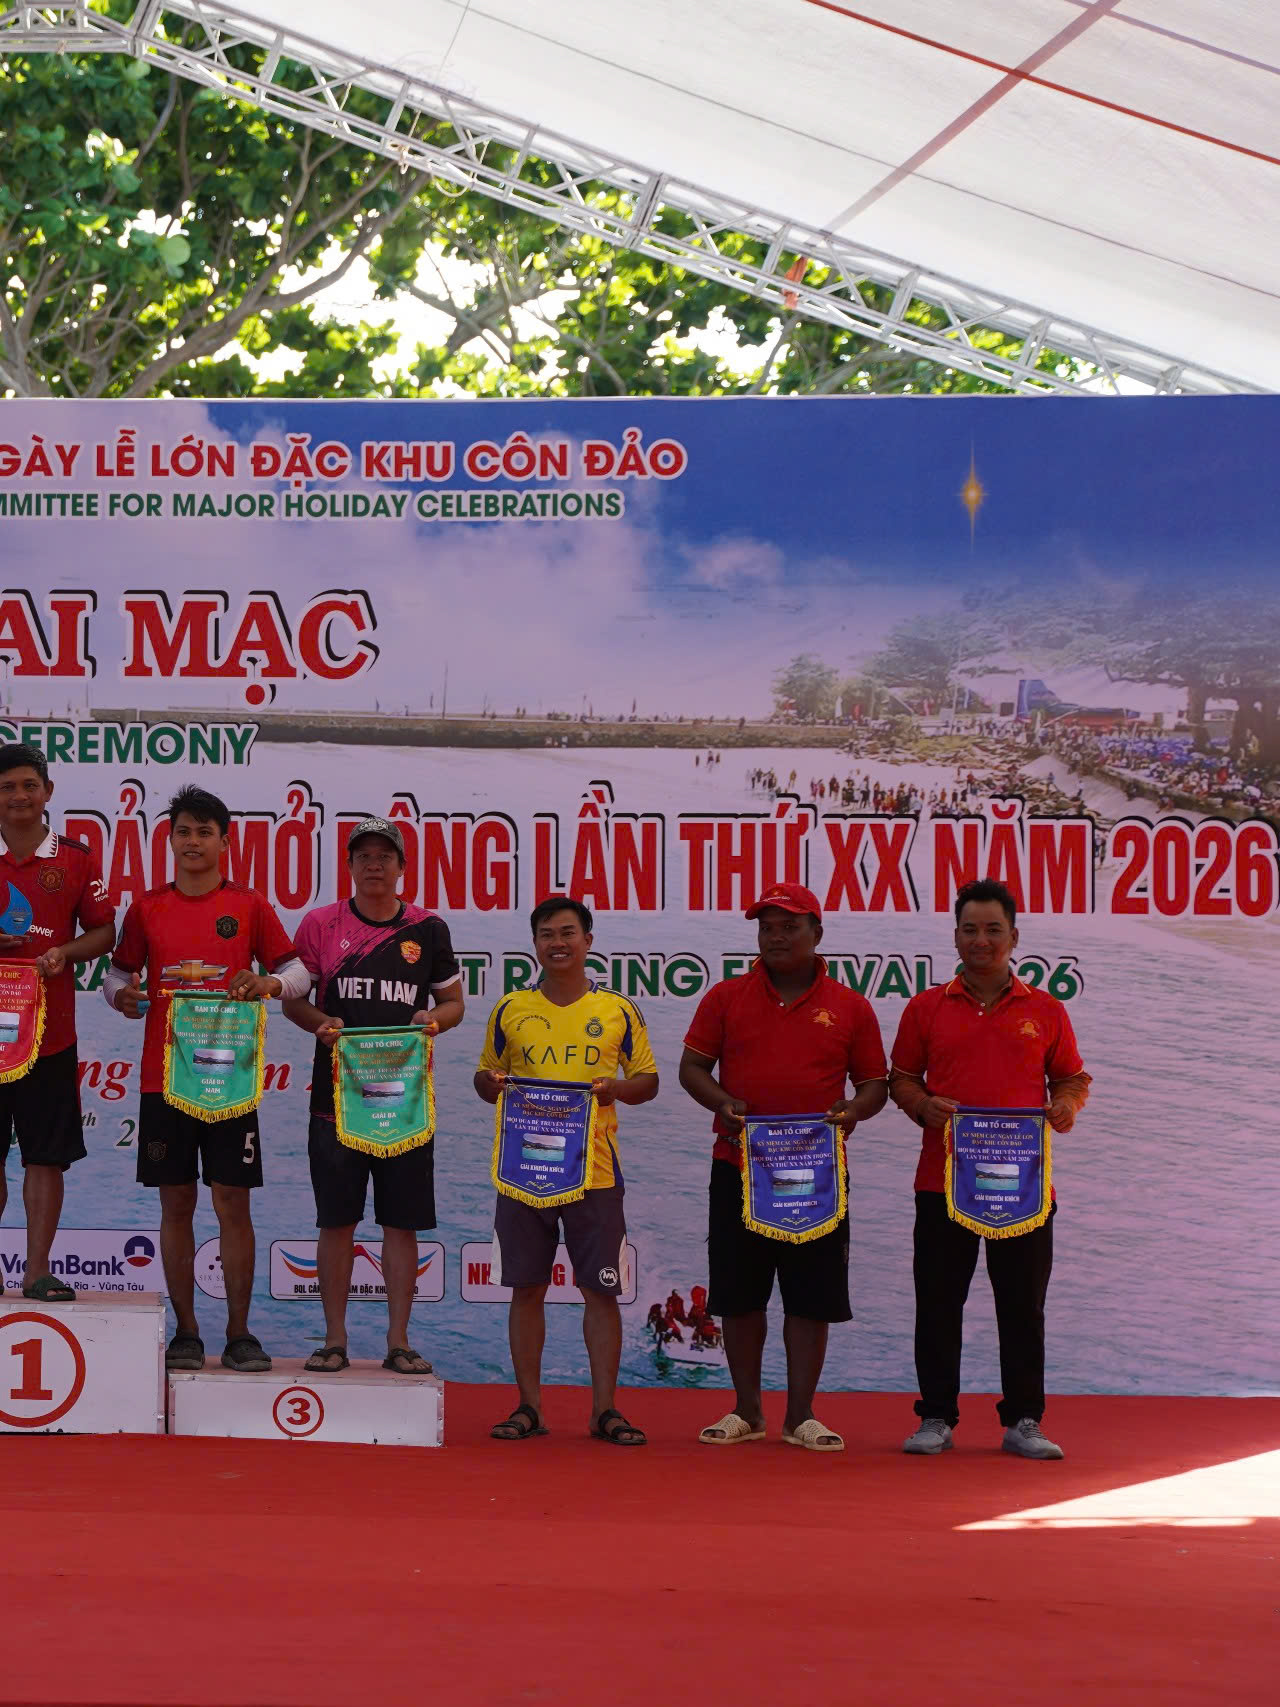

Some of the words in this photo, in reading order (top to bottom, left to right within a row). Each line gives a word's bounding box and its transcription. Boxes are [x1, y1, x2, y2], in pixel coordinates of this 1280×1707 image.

[96, 429, 136, 478] LỄ
[151, 435, 235, 479] LỚN
[250, 437, 349, 488] ĐẶC
[365, 445, 453, 479] KHU
[467, 436, 568, 479] CÔN
[583, 427, 684, 479] ĐẢO
[109, 492, 163, 518] FOR
[172, 492, 275, 518] MAJOR
[285, 492, 408, 518] HOLIDAY
[417, 492, 621, 518] CELEBRATIONS
[124, 598, 372, 706] MẠC
[227, 789, 316, 911] MỞ
[535, 789, 657, 911] LẦN
[679, 802, 809, 911] THỨ
[823, 822, 912, 912] XX
[934, 803, 1087, 914] NĂM
[1110, 824, 1274, 918] 2026
[337, 976, 375, 1000] VIET
[380, 978, 419, 1007] NAM
[503, 957, 704, 998] RING
[723, 959, 930, 999] FIVAL
[242, 1131, 256, 1164] 5
[0, 1253, 126, 1276] VinBank
[8, 1337, 54, 1401] 1
[284, 1396, 313, 1427] 3
